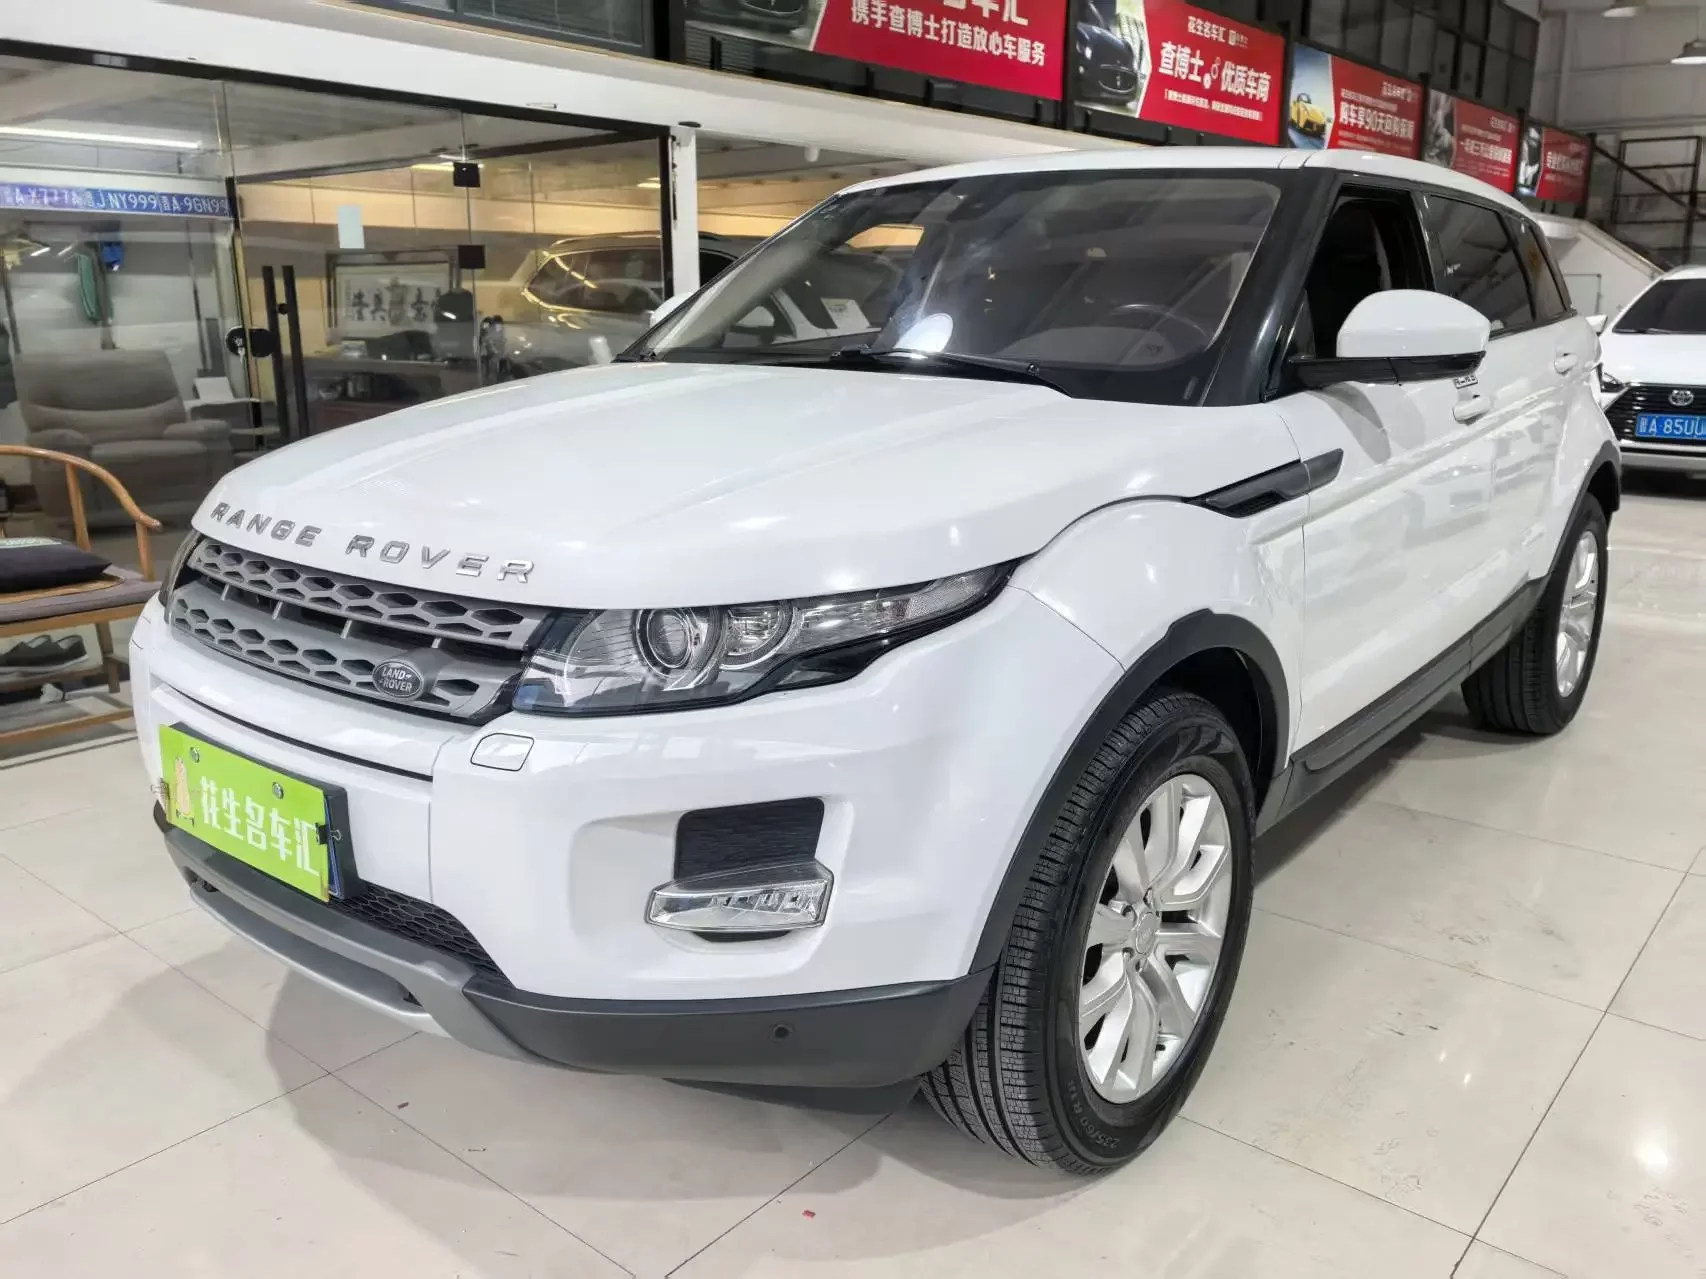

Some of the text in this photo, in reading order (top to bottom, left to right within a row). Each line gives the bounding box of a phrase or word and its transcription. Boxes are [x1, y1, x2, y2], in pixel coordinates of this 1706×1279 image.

[851, 0, 1046, 67] 携手查博士打造放心车服务
[1158, 41, 1272, 104] 查博士 优质车商
[210, 501, 535, 584] RANGE ROVER
[200, 775, 320, 877] 花生名车汇
